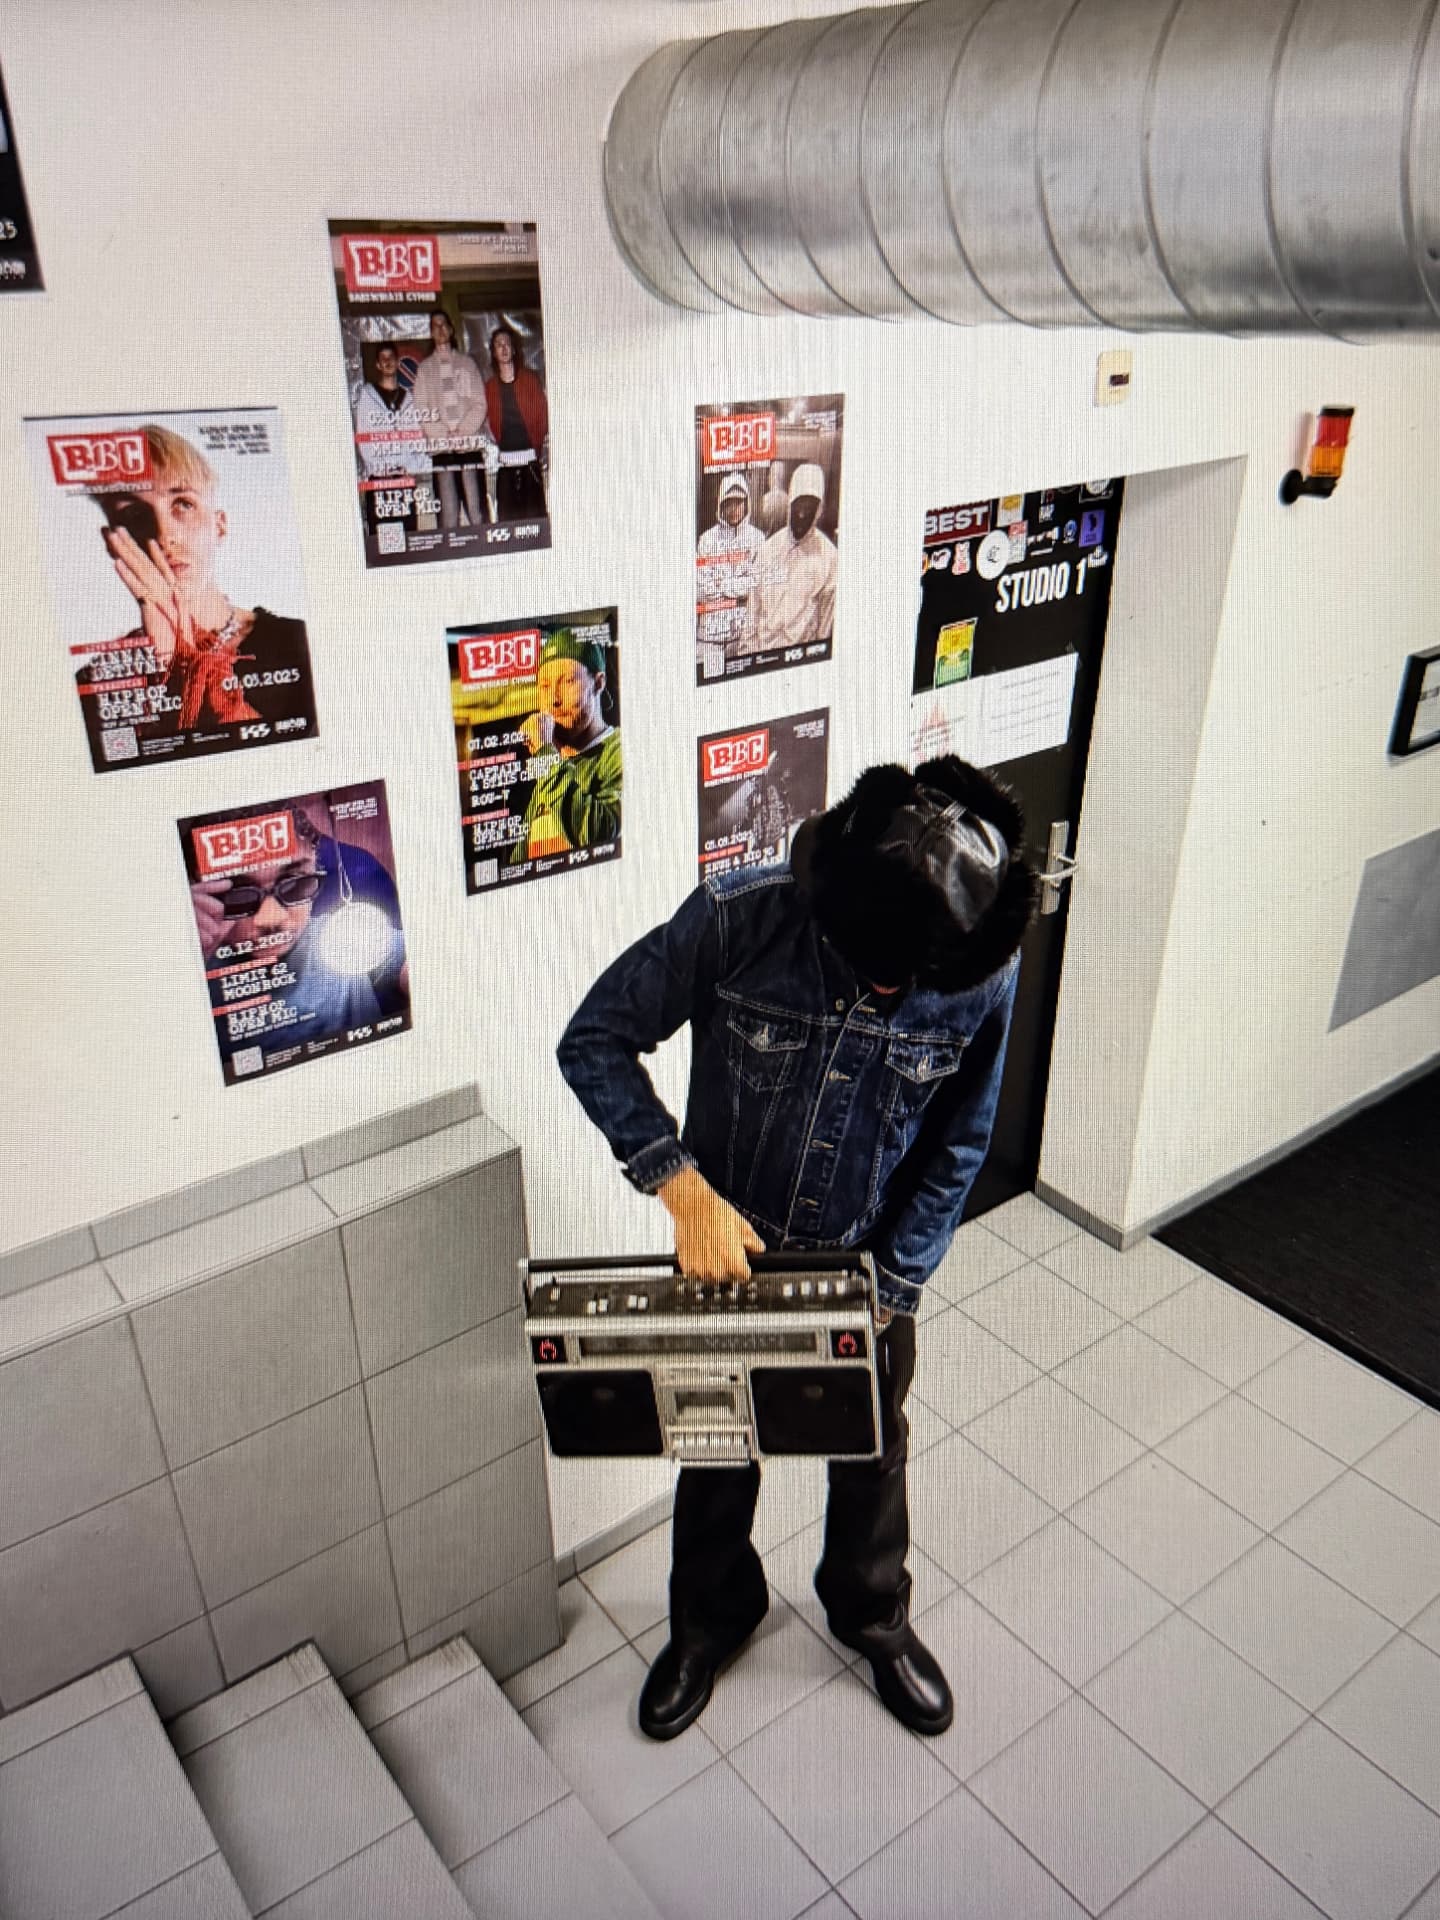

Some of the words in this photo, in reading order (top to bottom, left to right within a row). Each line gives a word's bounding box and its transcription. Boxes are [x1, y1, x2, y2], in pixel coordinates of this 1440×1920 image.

[349, 240, 433, 287] BBC
[55, 436, 145, 480] BBC
[711, 416, 772, 461] BBC
[995, 561, 1071, 613] STUDIO
[1076, 558, 1087, 595] 1
[464, 635, 536, 679] BBC
[708, 733, 765, 776] BBC
[201, 816, 288, 868] BBC
[221, 967, 268, 989] LIMIT
